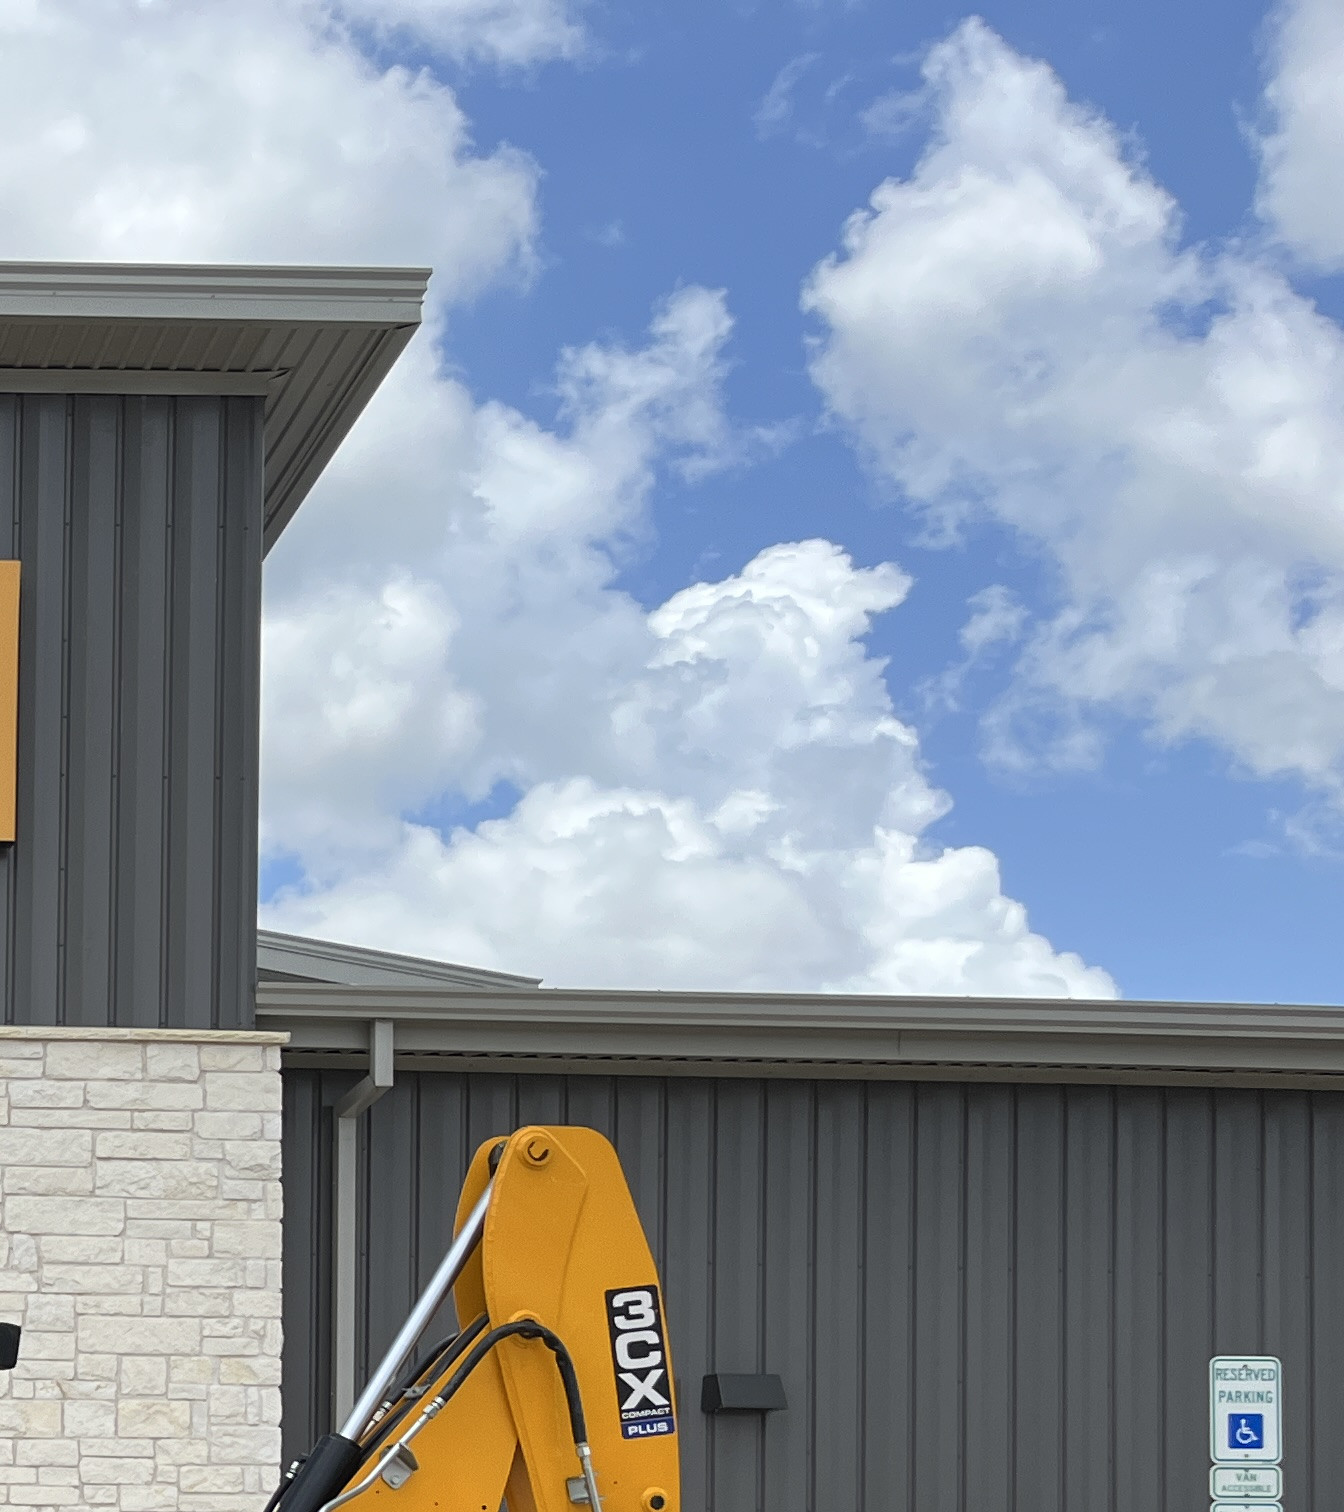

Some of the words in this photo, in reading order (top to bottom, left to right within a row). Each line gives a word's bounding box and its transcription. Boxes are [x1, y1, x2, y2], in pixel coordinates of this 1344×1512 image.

[612, 1290, 670, 1410] 3CX
[1215, 1368, 1276, 1382] RESERVED
[1218, 1390, 1273, 1404] PARKING
[621, 1407, 670, 1420] COMPACT
[627, 1421, 669, 1436] PLUS
[1236, 1473, 1257, 1481] VAN
